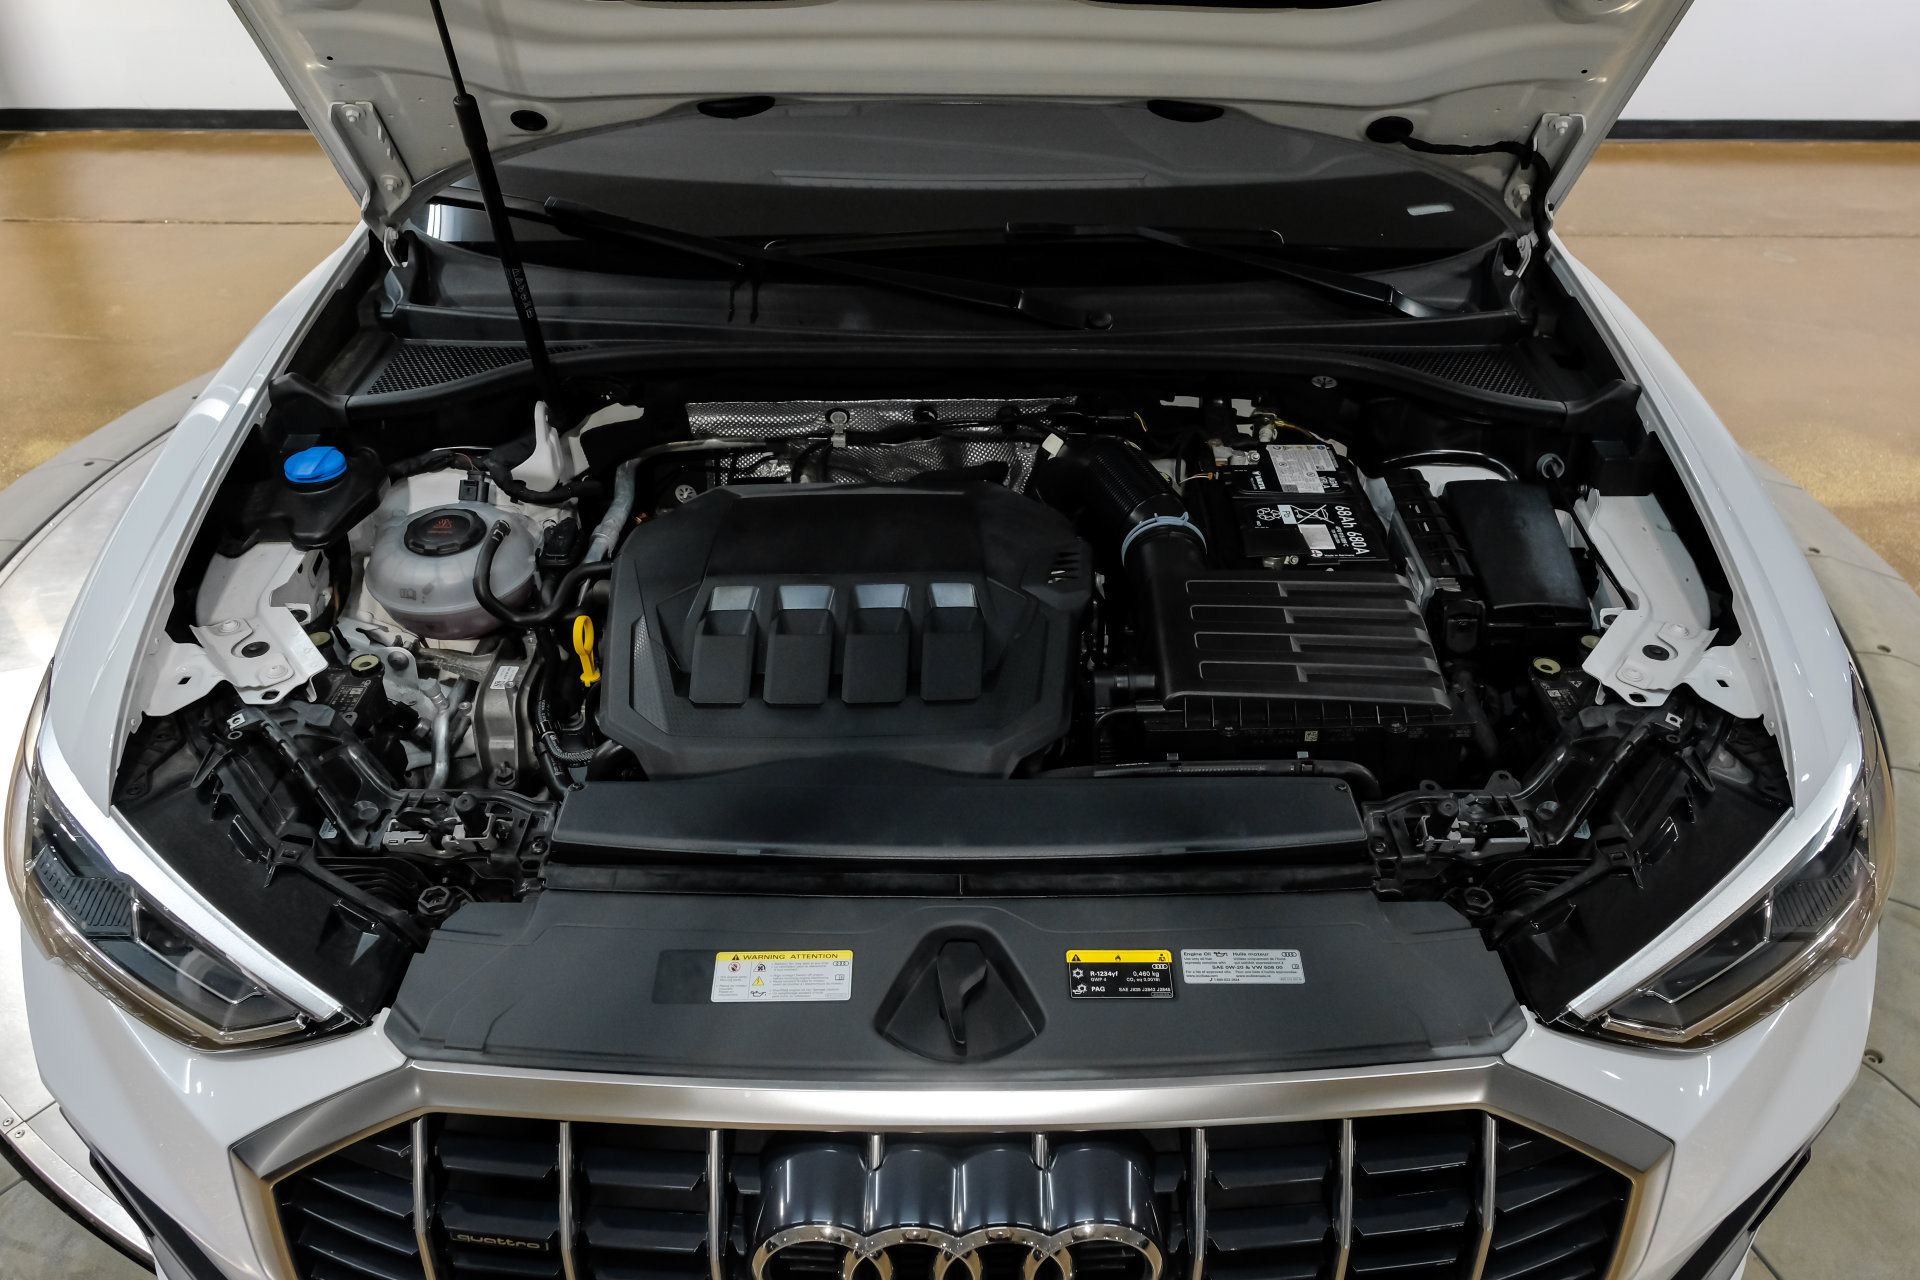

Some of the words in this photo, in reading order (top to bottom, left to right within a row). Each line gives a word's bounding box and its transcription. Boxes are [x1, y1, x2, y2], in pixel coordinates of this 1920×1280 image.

[1334, 506, 1357, 528] 68Ah
[1347, 531, 1370, 555] 680A
[457, 1234, 540, 1249] quattro
